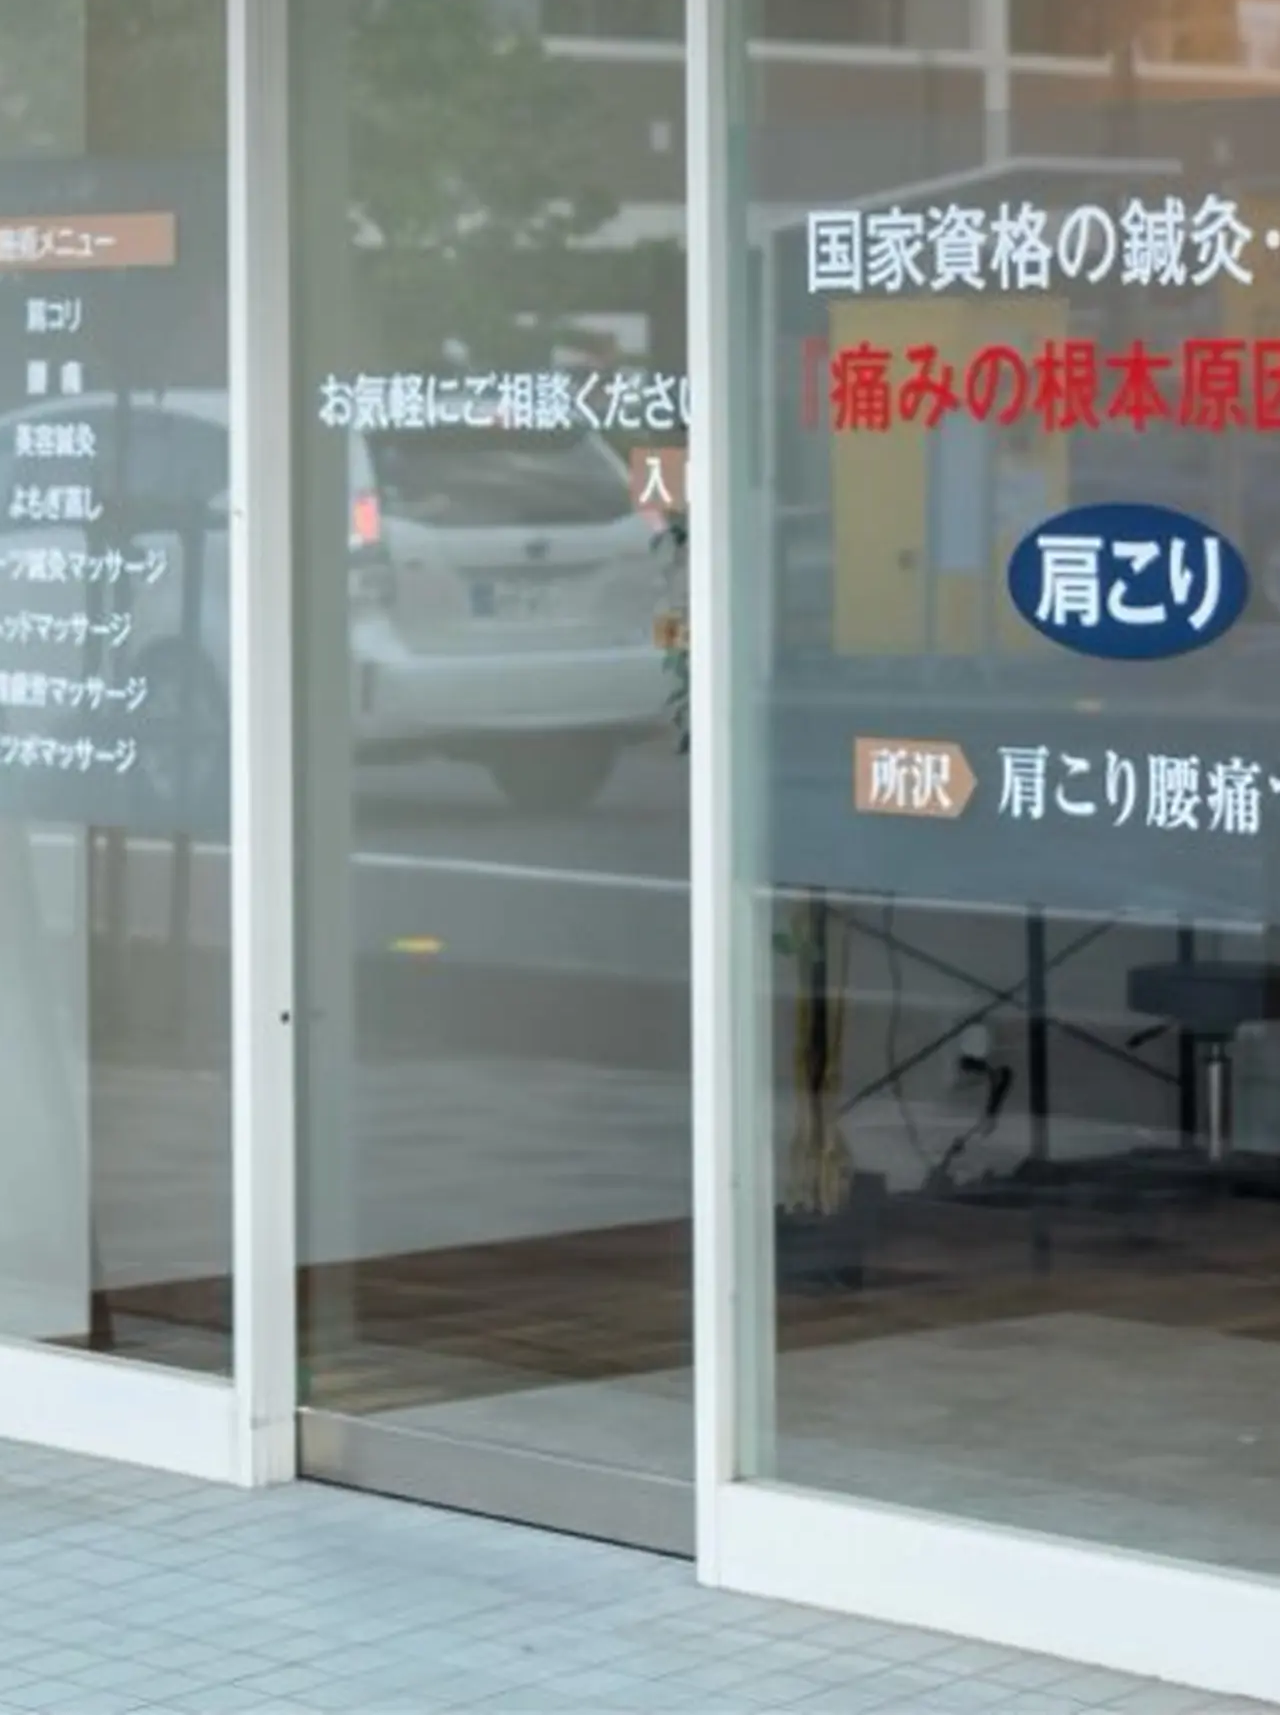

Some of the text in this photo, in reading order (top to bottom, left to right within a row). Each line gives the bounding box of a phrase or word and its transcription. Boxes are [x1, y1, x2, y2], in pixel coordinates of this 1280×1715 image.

[639, 455, 690, 505] 入
[1034, 534, 1224, 632] 肩こり
[868, 746, 955, 812] 所沢
